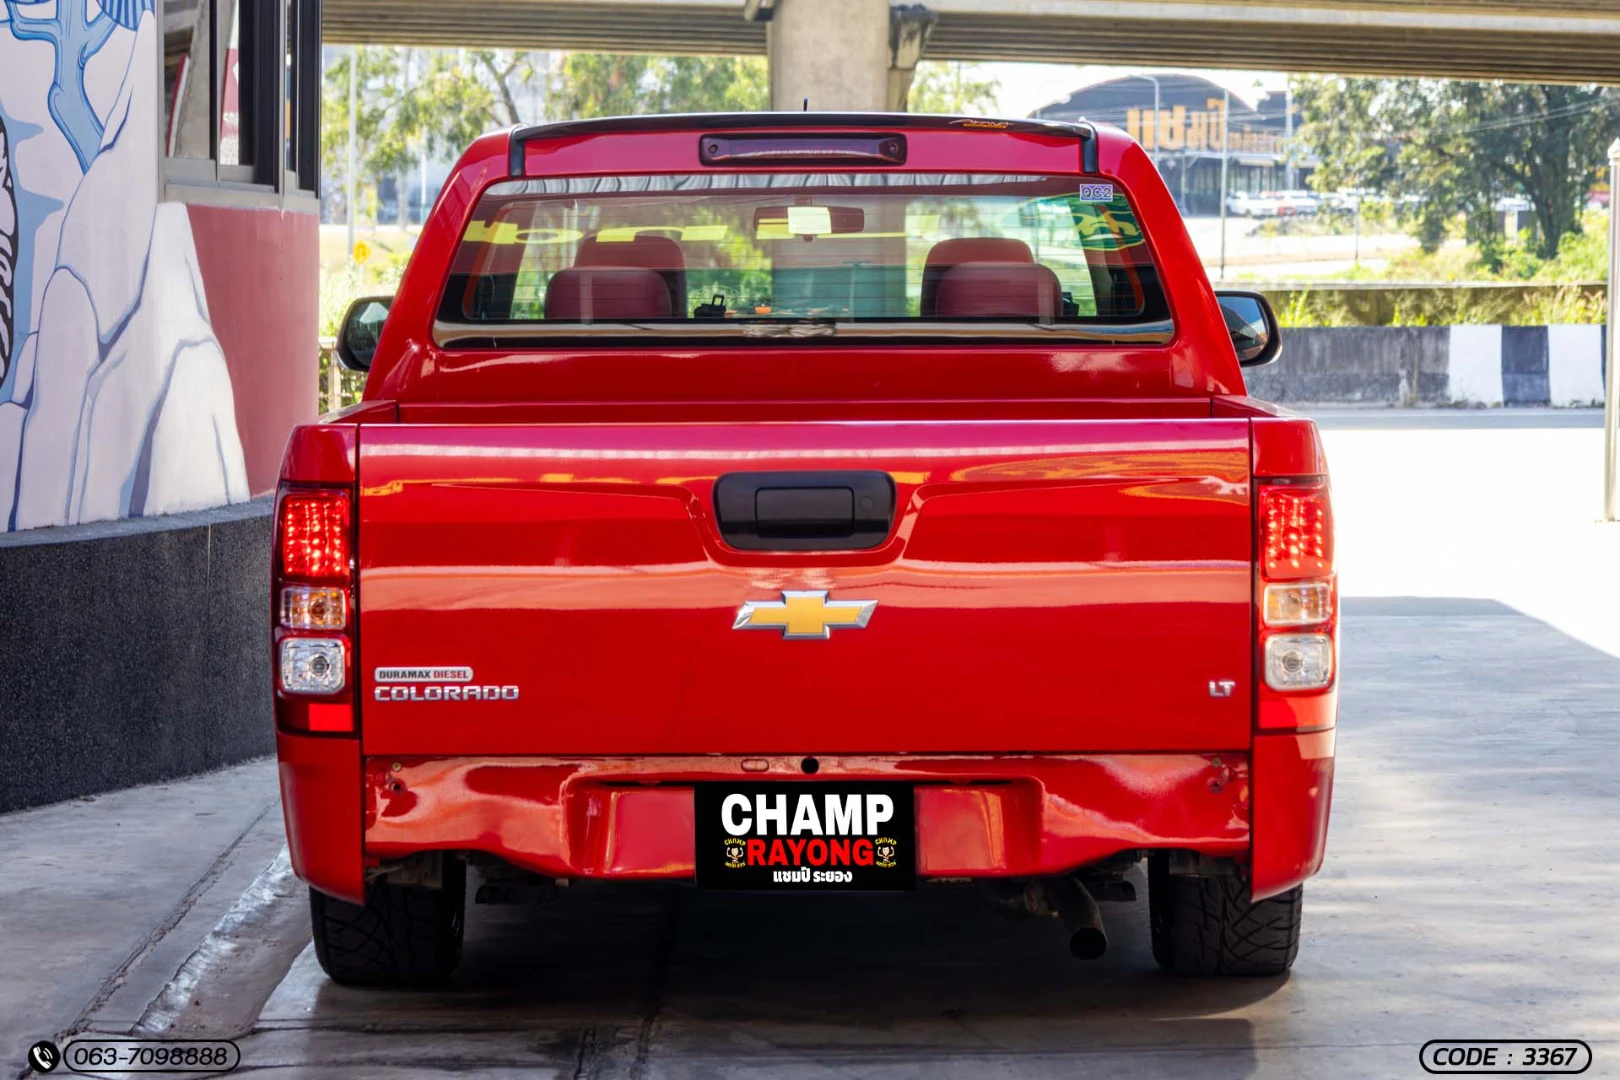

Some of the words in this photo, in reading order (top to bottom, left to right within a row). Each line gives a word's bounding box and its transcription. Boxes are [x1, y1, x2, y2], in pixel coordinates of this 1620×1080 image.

[1081, 187, 1112, 199] QC2
[379, 670, 431, 679] DURAMAX
[433, 670, 469, 679] DIESEL
[374, 685, 520, 701] COLORADO
[1209, 680, 1236, 697] LT
